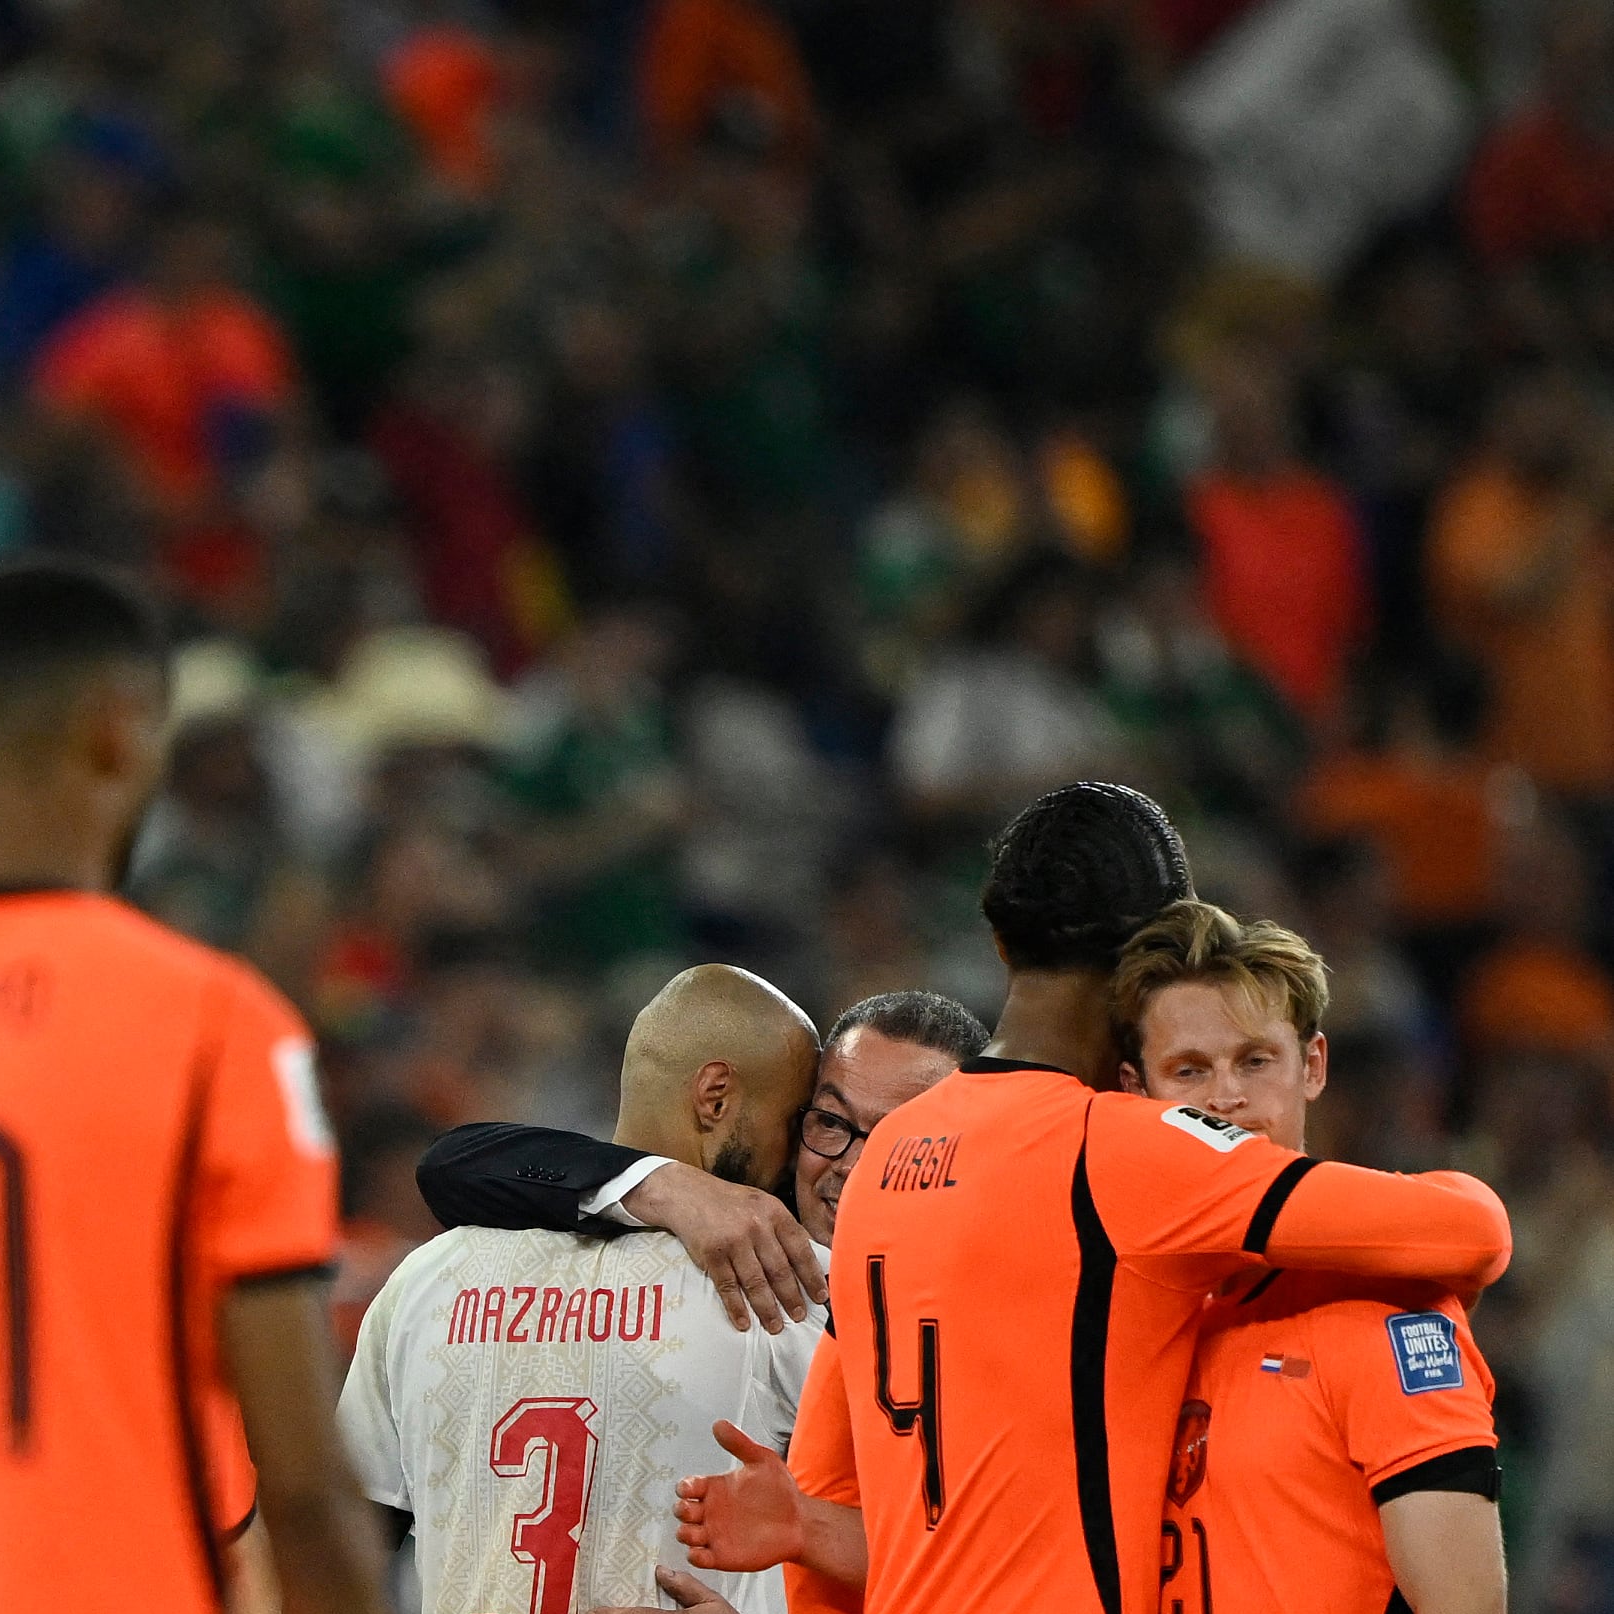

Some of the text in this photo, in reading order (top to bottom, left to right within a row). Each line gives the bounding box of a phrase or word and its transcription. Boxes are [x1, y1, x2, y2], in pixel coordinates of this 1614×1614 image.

[881, 1134, 962, 1191] VIRGIL
[447, 1284, 664, 1344] MAZRAOUI
[1401, 1323, 1444, 1338] FOOTBALL
[1404, 1336, 1449, 1355] UNITES
[866, 1255, 946, 1531] 4
